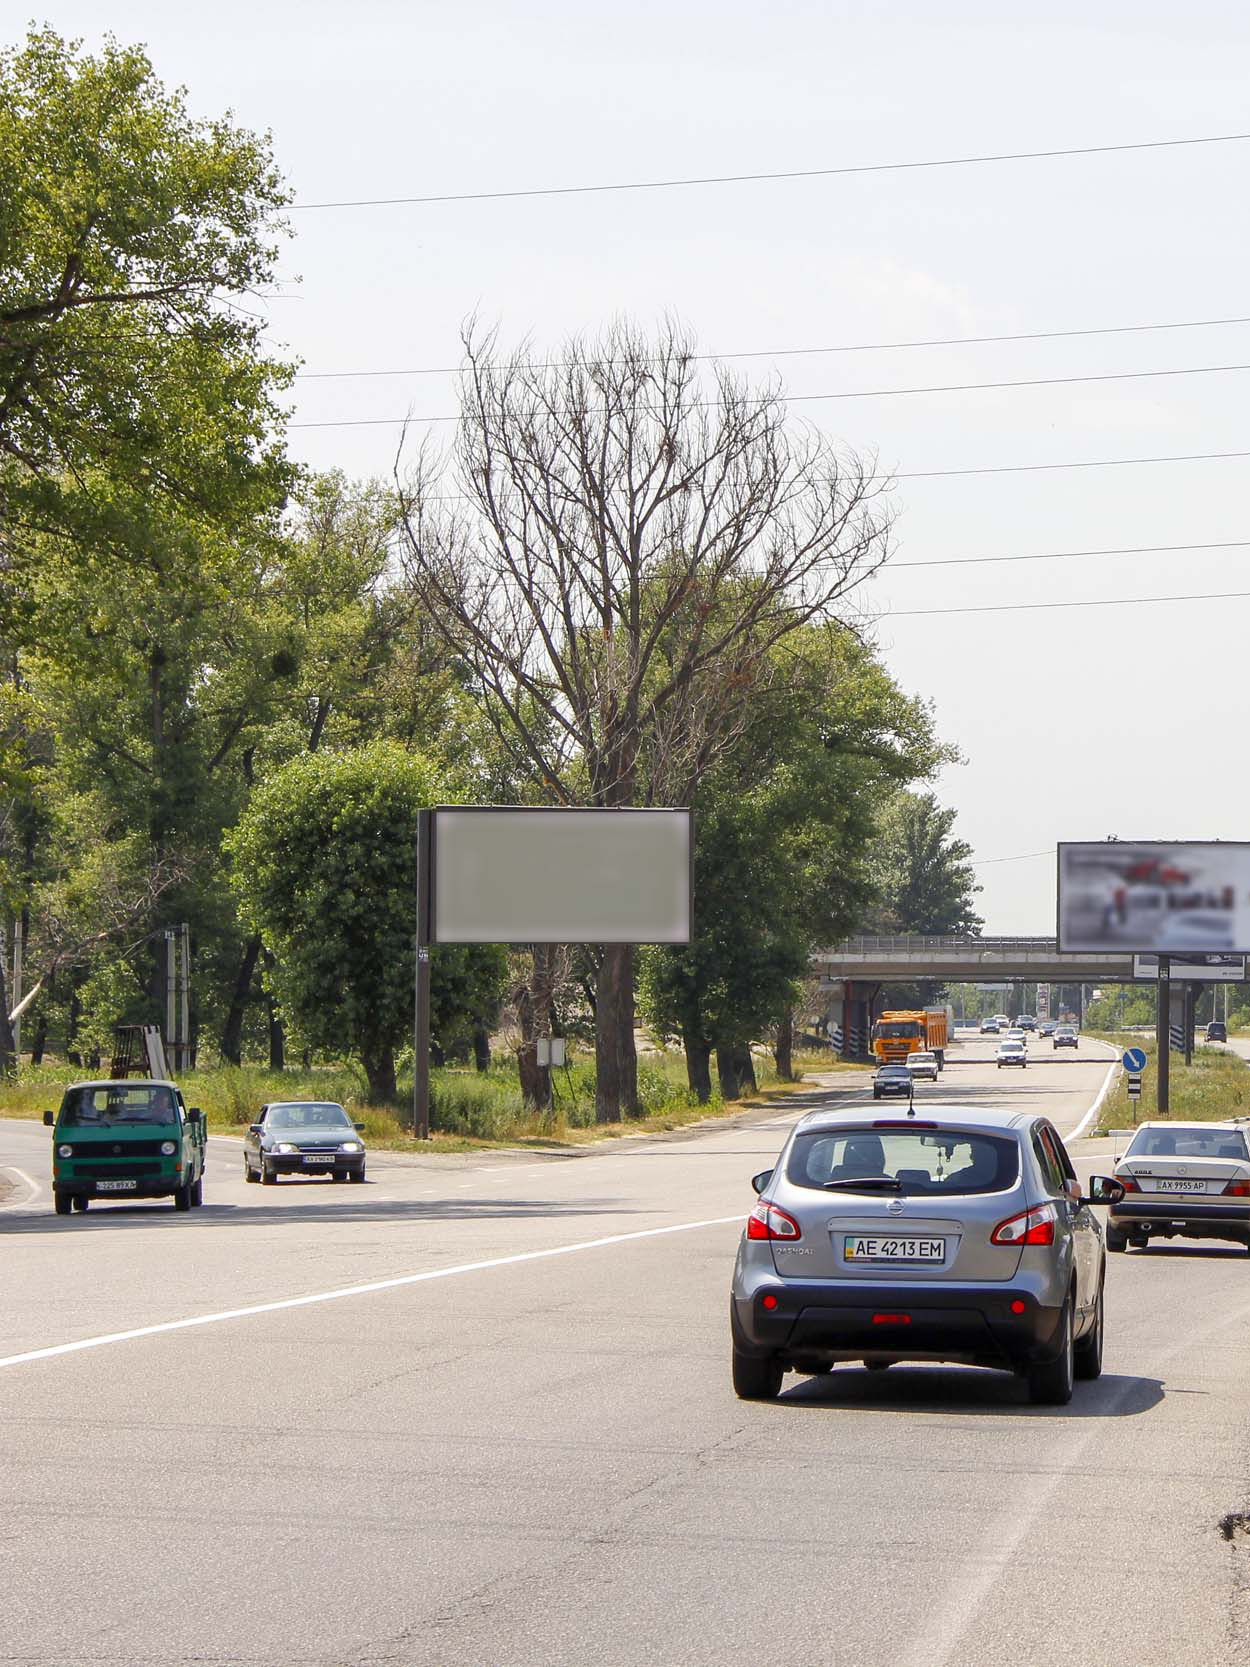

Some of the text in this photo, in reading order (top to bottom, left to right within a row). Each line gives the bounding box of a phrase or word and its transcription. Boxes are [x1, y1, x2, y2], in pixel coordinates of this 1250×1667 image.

[1162, 1181, 1205, 1190] AX 9955 AP
[856, 1240, 941, 1257] AE 4213 EM
